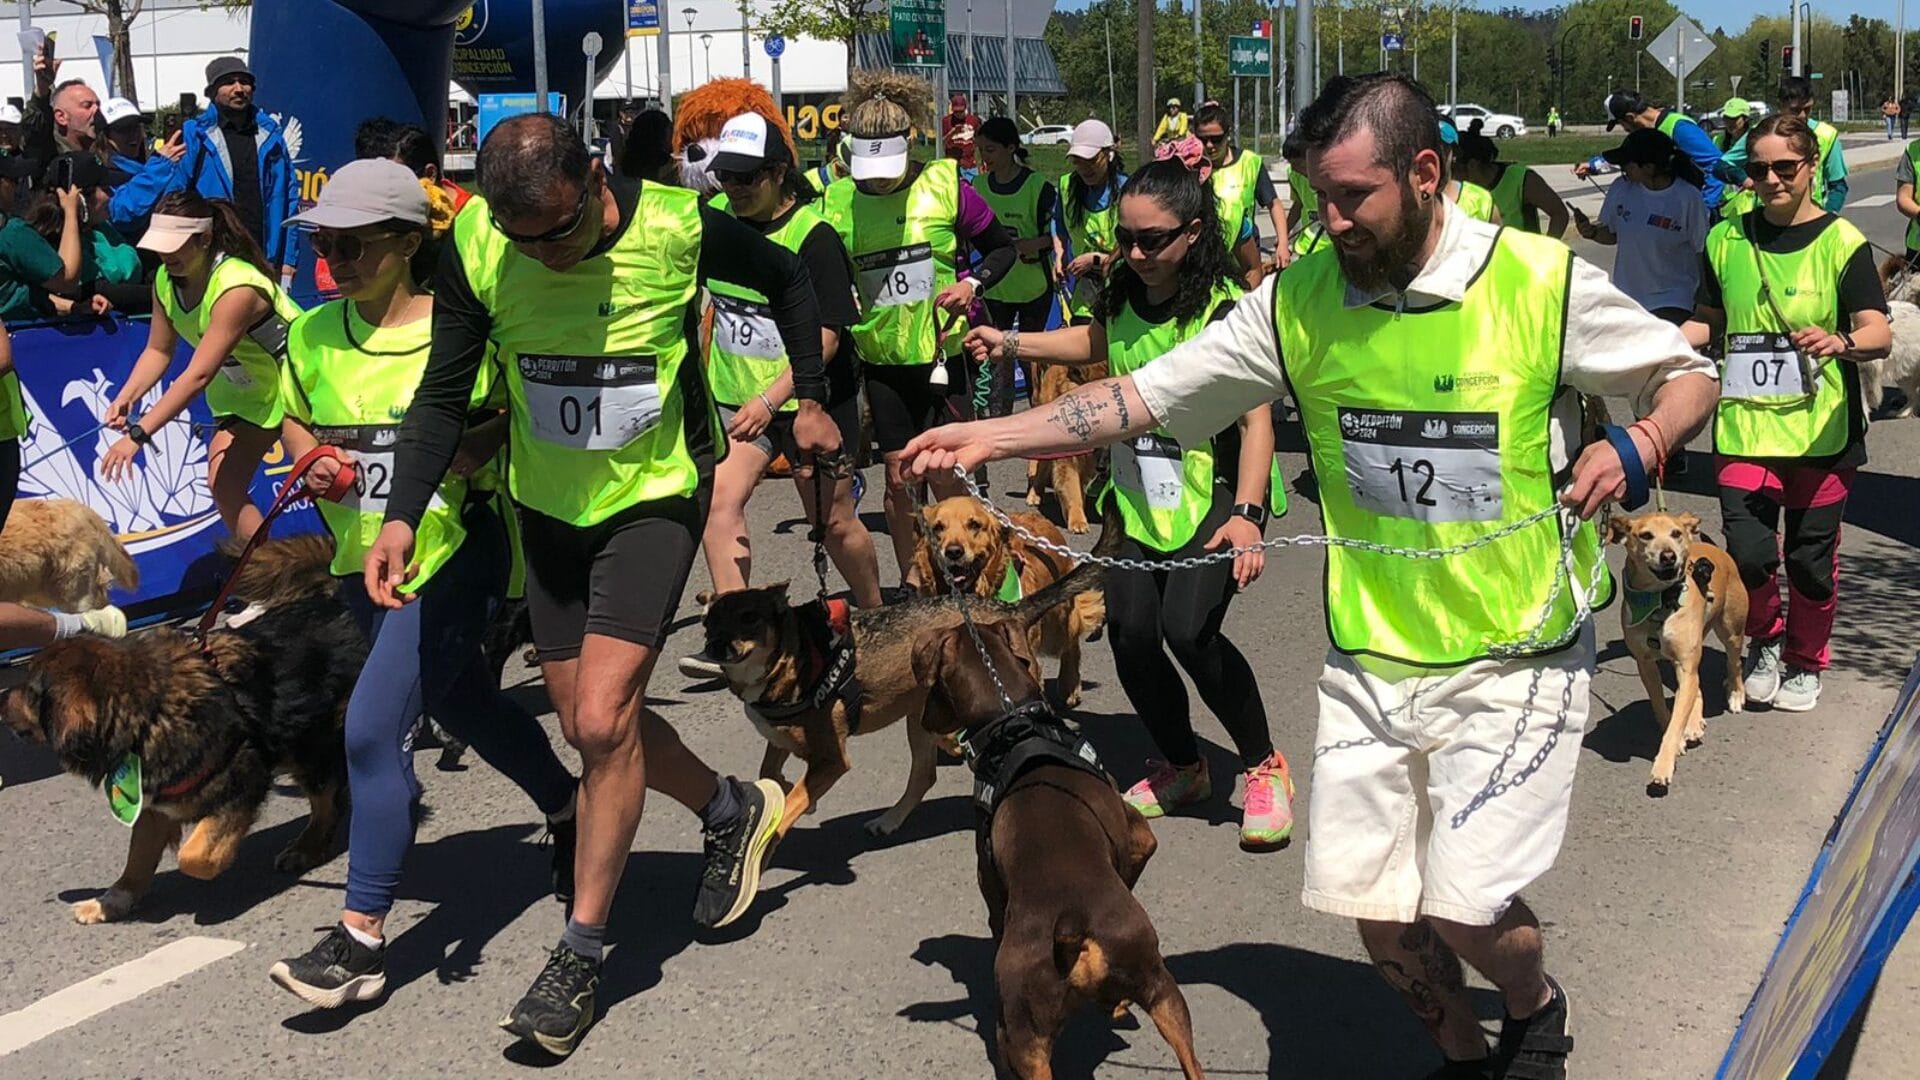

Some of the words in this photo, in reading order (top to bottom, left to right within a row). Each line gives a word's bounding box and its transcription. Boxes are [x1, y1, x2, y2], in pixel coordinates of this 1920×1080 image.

[882, 271, 909, 297] 18
[730, 319, 753, 346] 19
[1752, 359, 1785, 387] 07
[559, 395, 602, 436] 01
[1359, 429, 1377, 439] 2024
[354, 460, 389, 499] 02
[1390, 457, 1437, 507] 12
